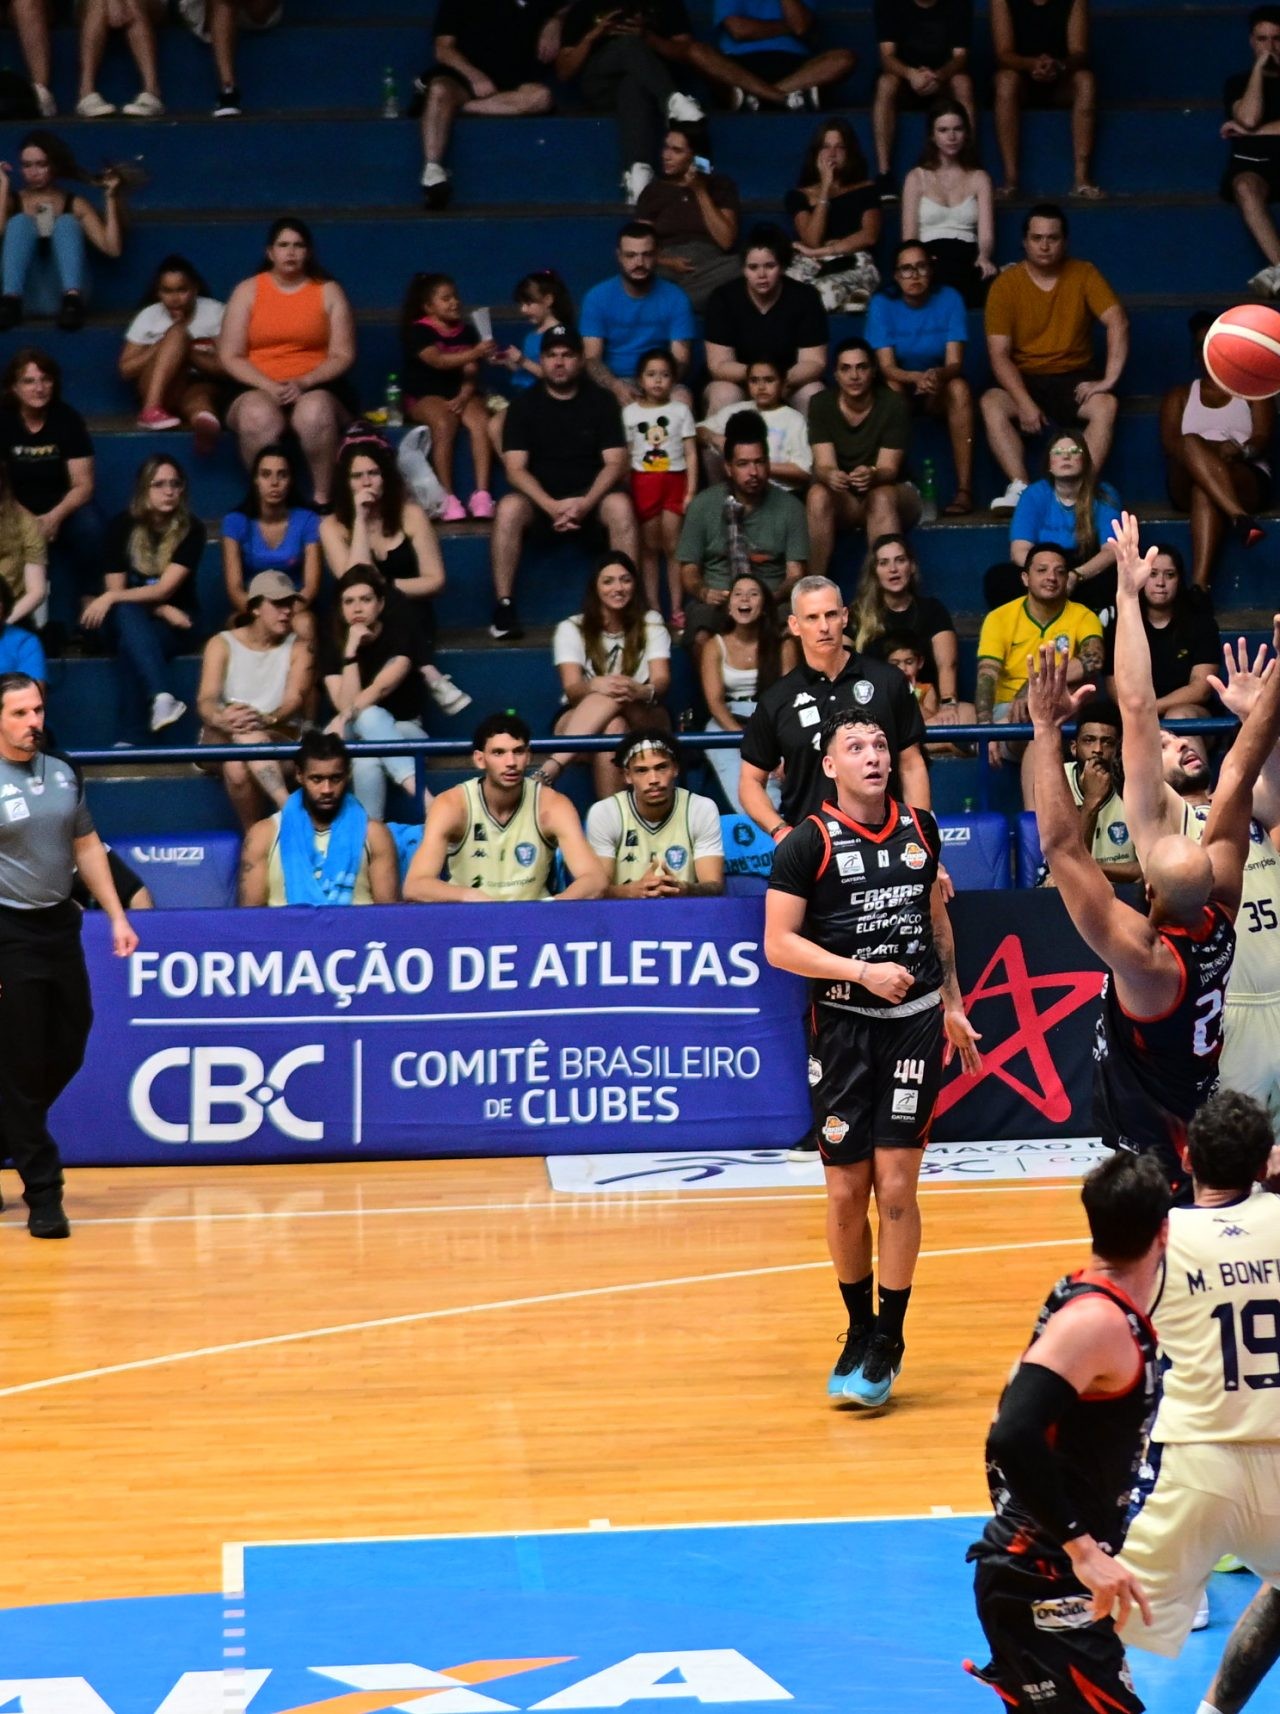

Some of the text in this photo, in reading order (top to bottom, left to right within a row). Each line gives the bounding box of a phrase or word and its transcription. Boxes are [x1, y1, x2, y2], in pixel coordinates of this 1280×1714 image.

[938, 827, 971, 841] IZZI
[850, 884, 924, 905] CAXIAS
[863, 900, 885, 912] DO
[1242, 898, 1278, 933] 35
[130, 941, 760, 1007] FORMAÇÃO DE ATLETAS
[392, 1040, 760, 1088] COMITÊ BRASILEIRO
[894, 1058, 925, 1085] 44
[130, 1044, 325, 1143] CBC
[486, 1086, 680, 1126] DE CLUBES
[920, 1159, 995, 1175] BC
[1186, 1269, 1213, 1296] M.
